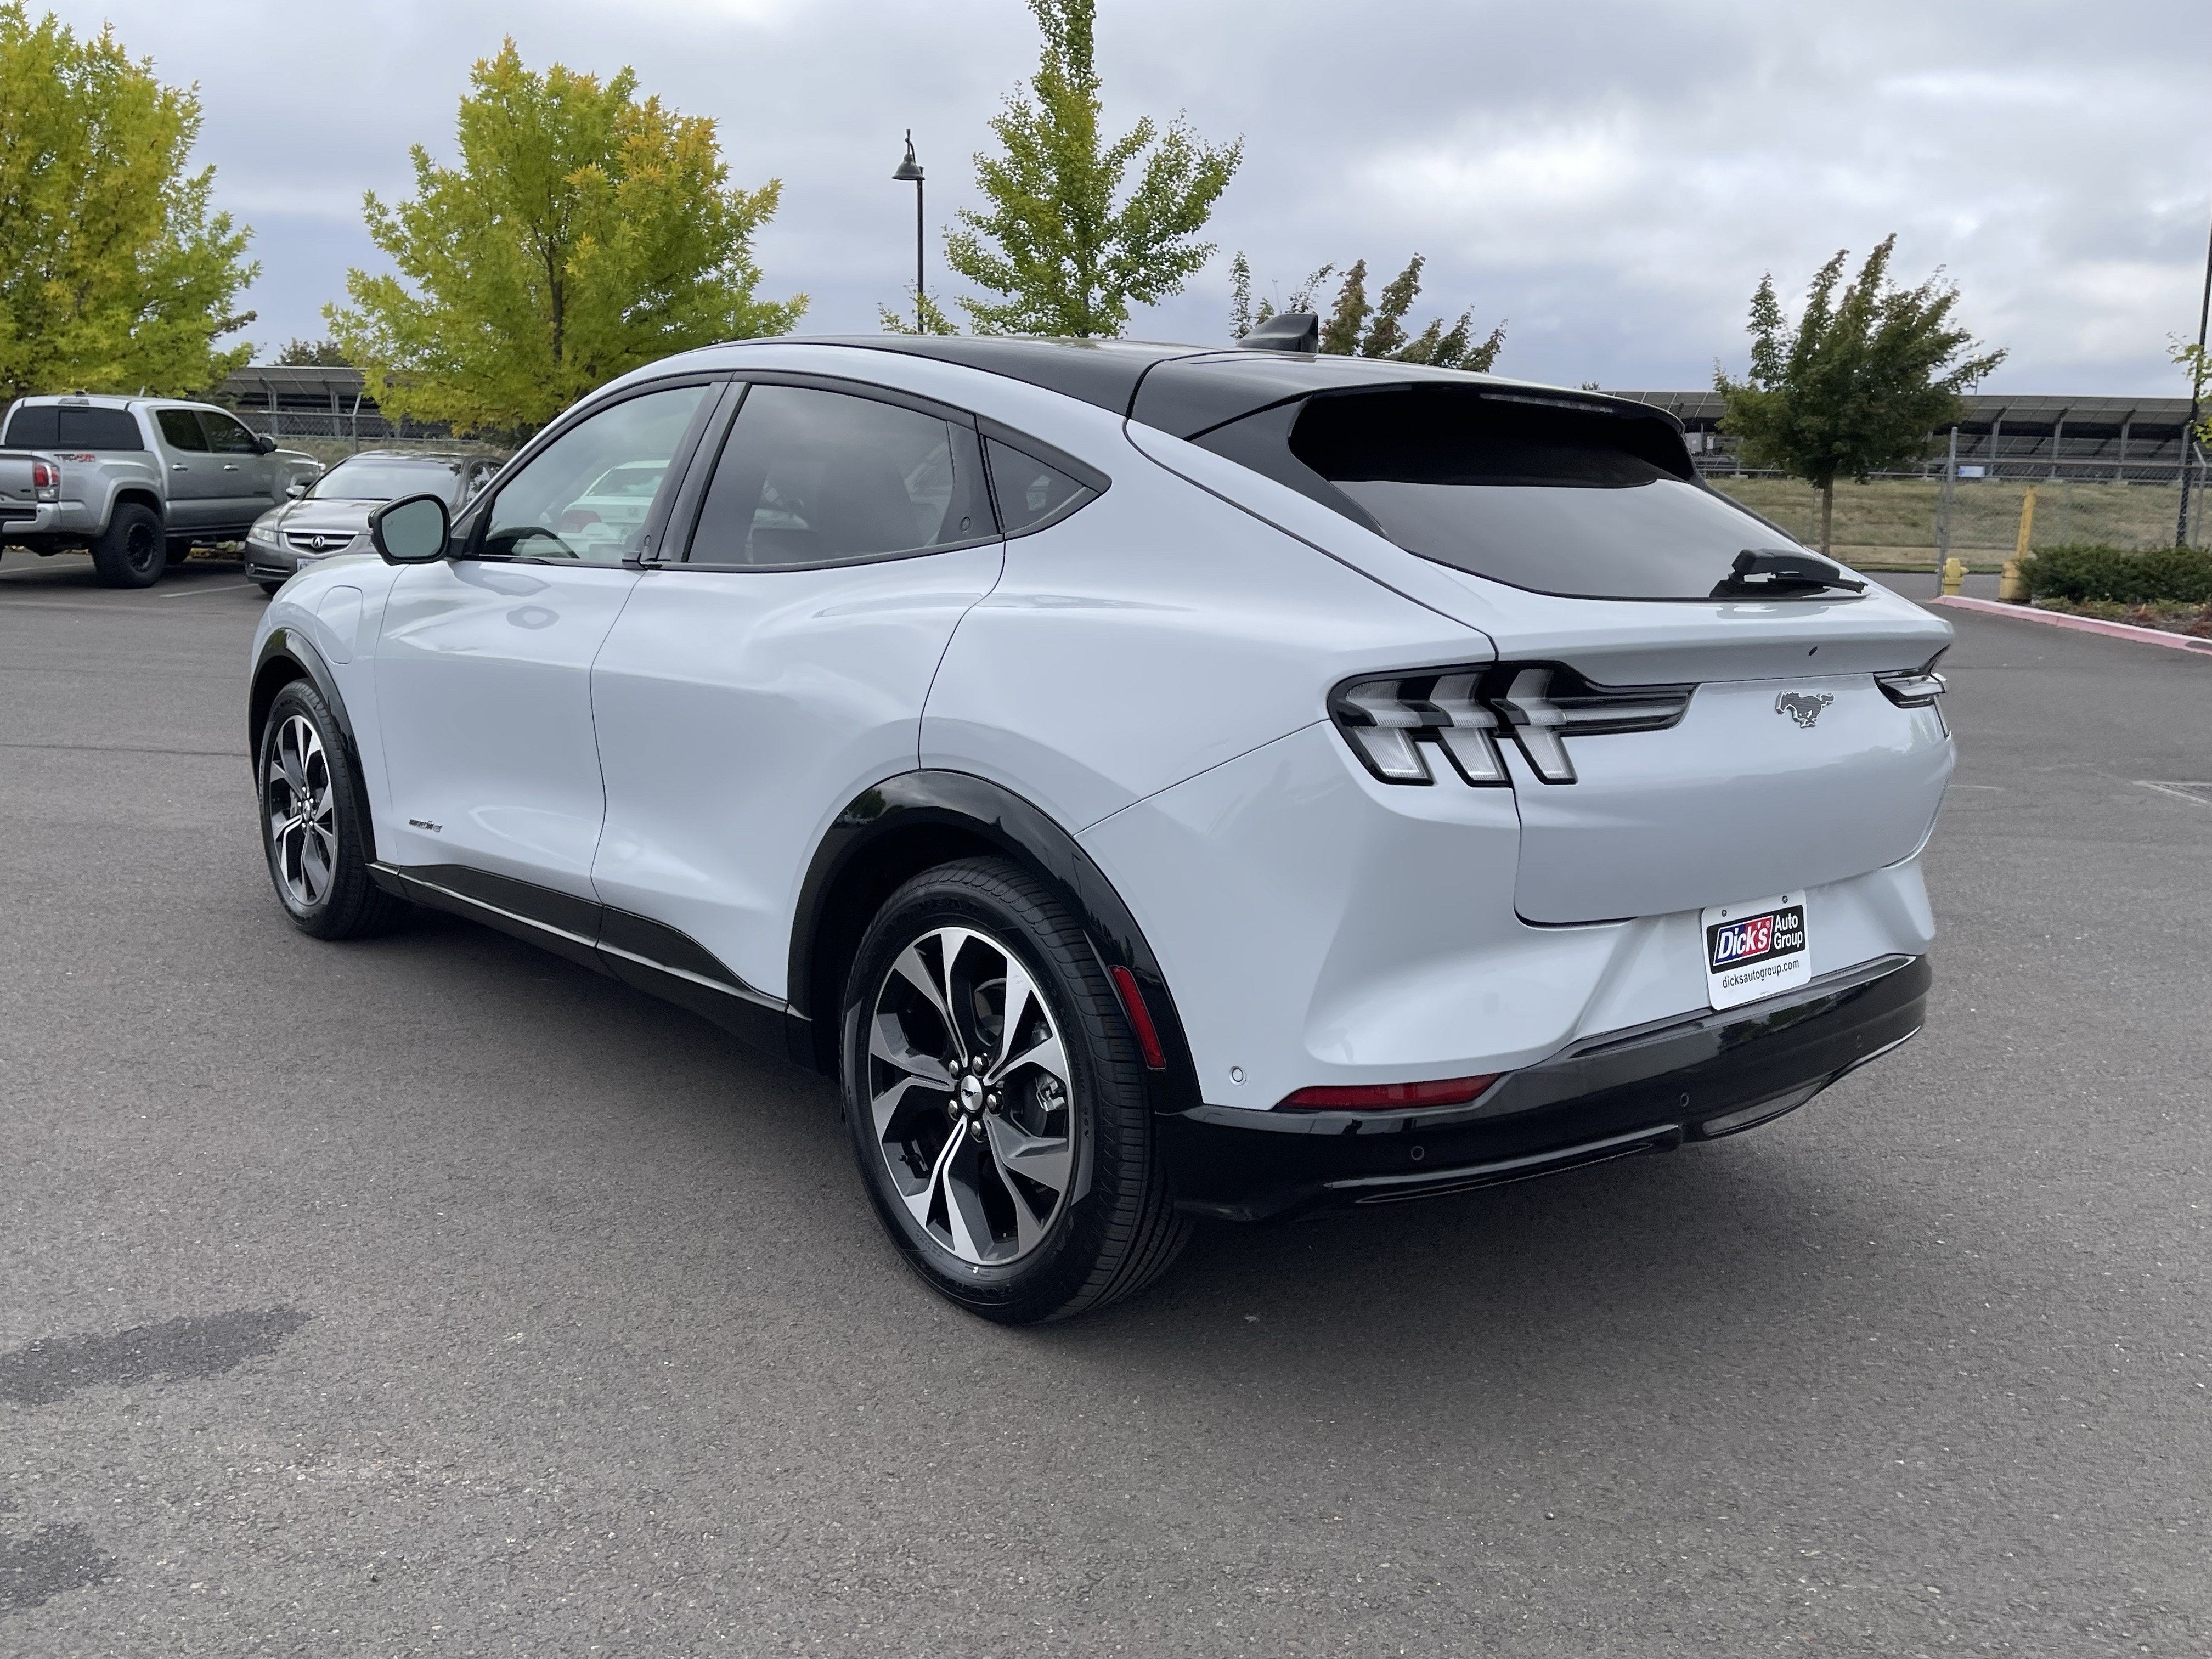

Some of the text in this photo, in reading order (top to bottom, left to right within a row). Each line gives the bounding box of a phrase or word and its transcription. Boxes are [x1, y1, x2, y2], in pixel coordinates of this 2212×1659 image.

[1774, 913, 1798, 933] Auto
[1718, 923, 1768, 960] Dick's
[1774, 931, 1803, 950] Group
[1722, 960, 1799, 988] dicksautogroup.com
